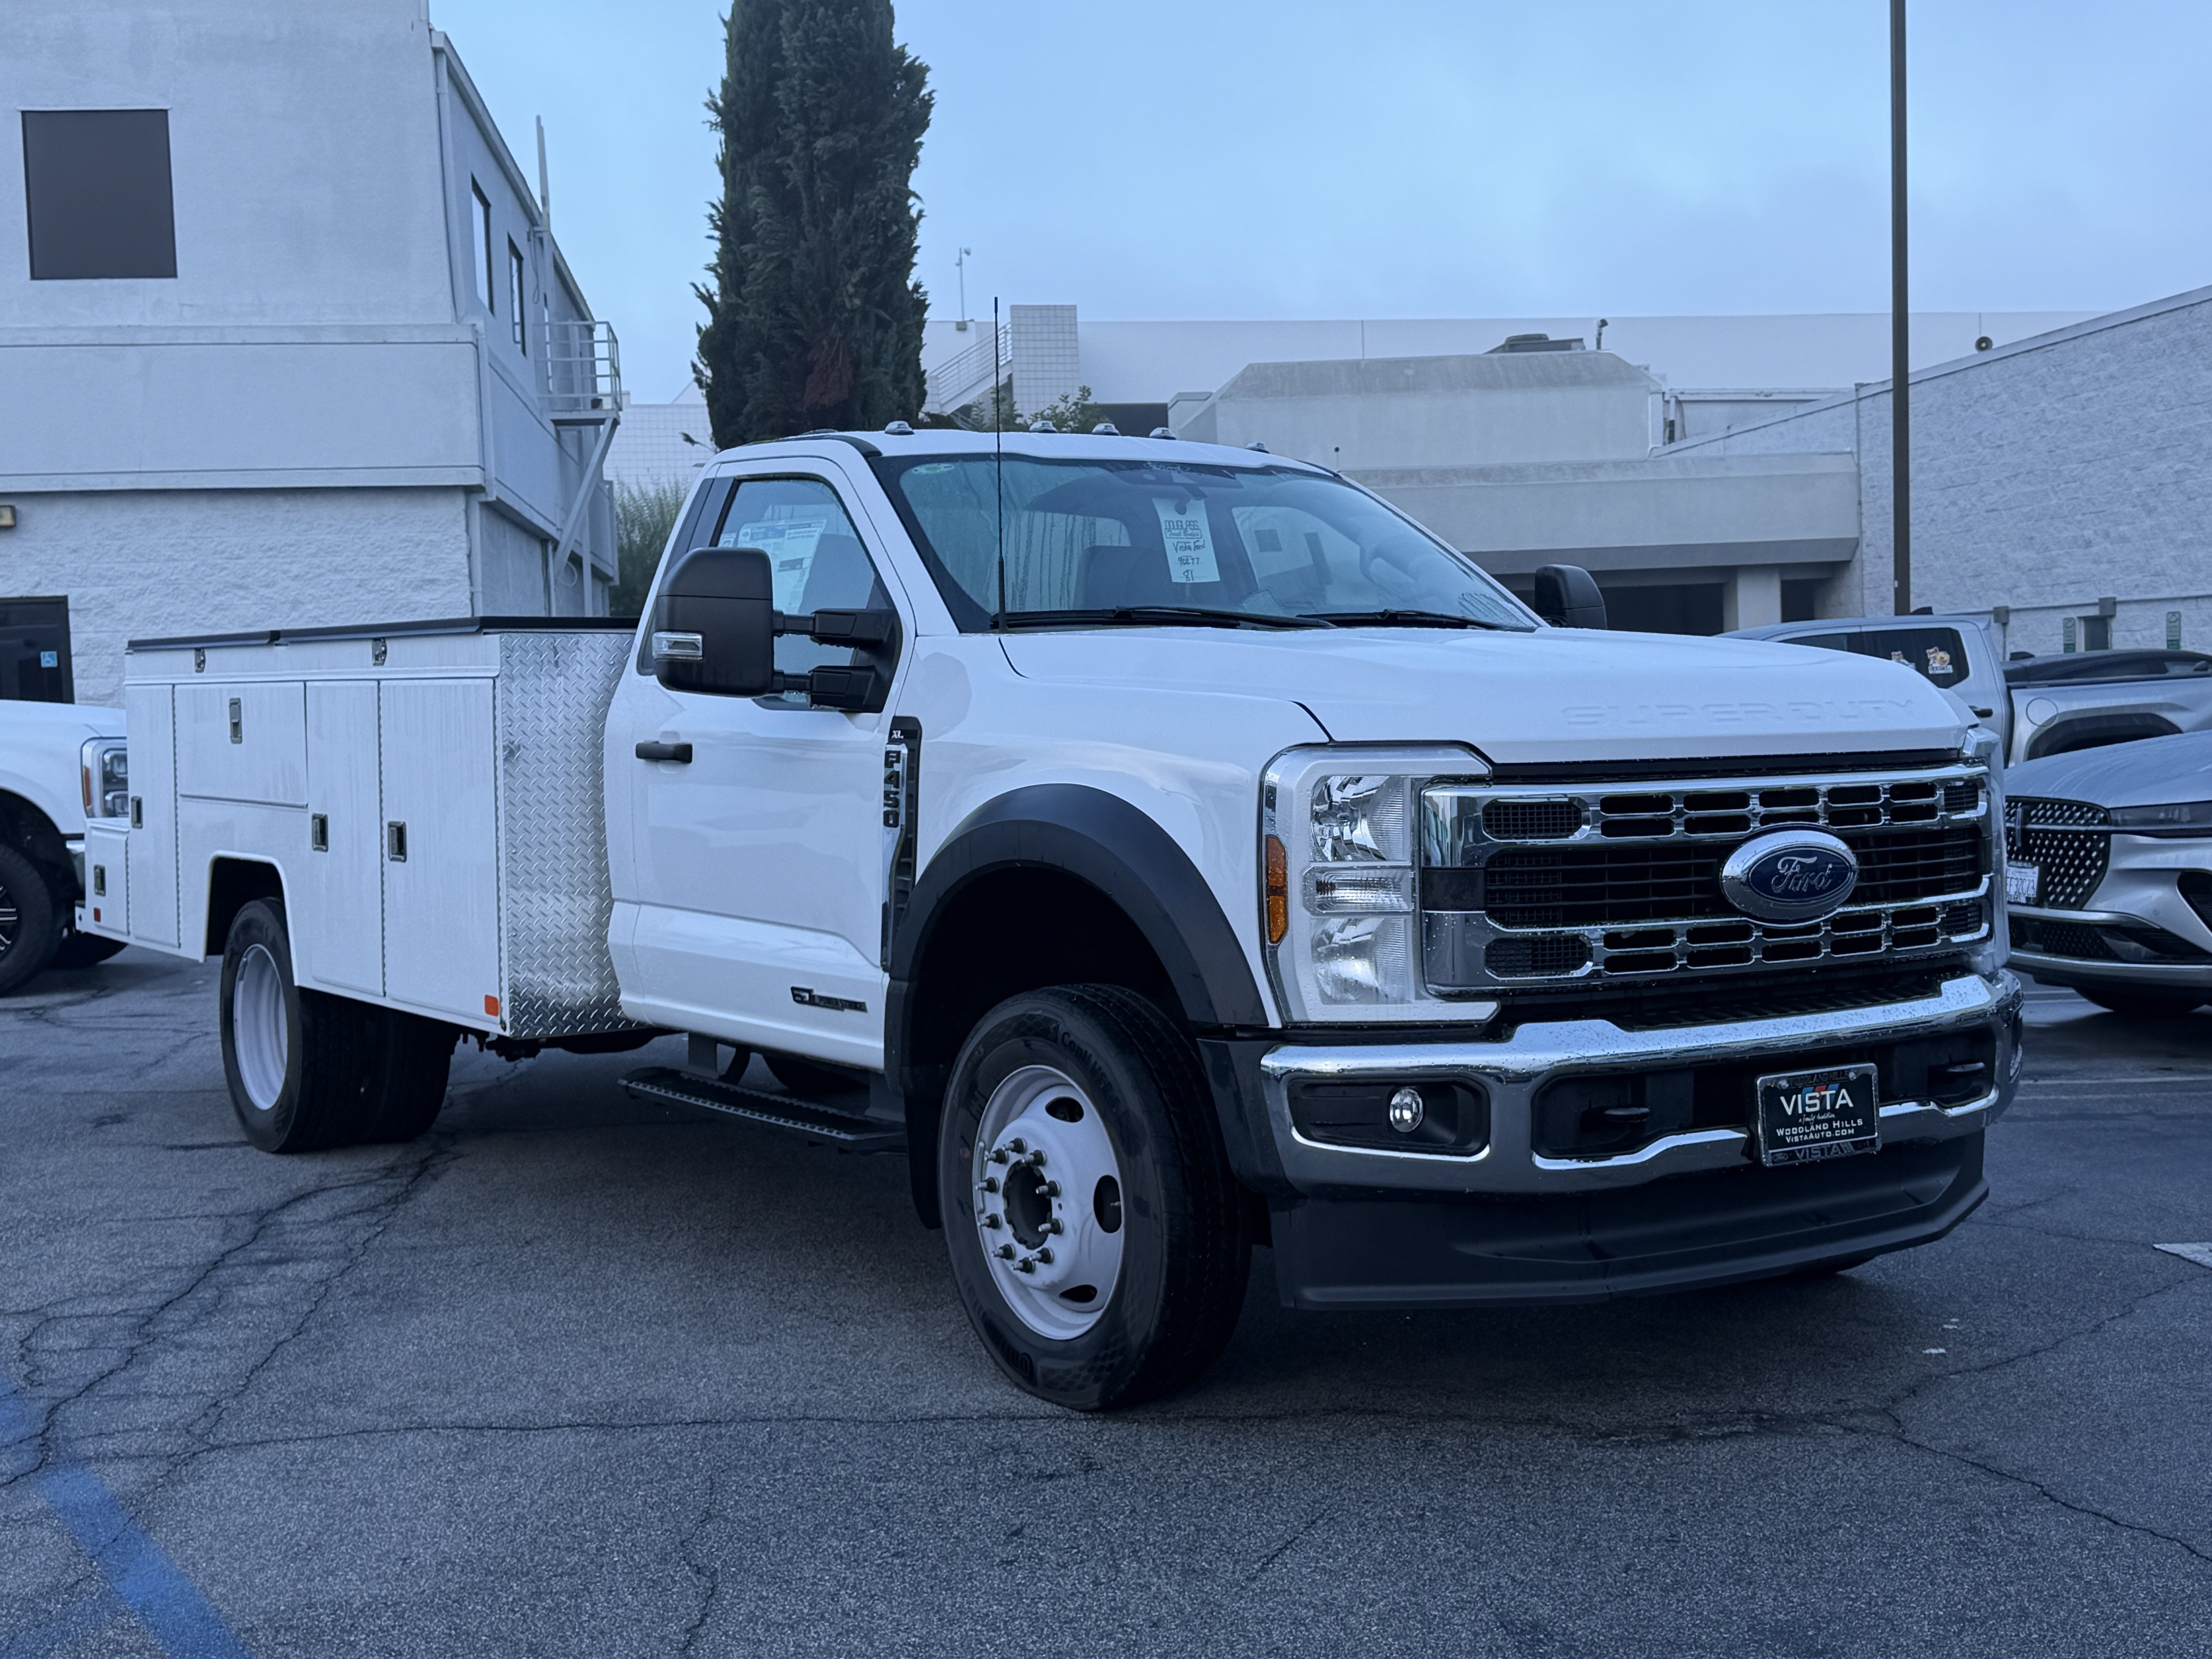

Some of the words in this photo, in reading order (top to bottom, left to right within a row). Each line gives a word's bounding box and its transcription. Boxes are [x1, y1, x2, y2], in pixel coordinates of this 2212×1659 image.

[1561, 702, 1782, 726] SUPER
[1787, 699, 1913, 720] DUTY
[891, 730, 903, 739] XL
[1771, 856, 1832, 893] Ford
[1780, 1089, 1854, 1115] VISTA
[1776, 1123, 1829, 1137] WOODLAND
[1832, 1119, 1863, 1128] HILLS
[1795, 1144, 1842, 1160] VISTA
